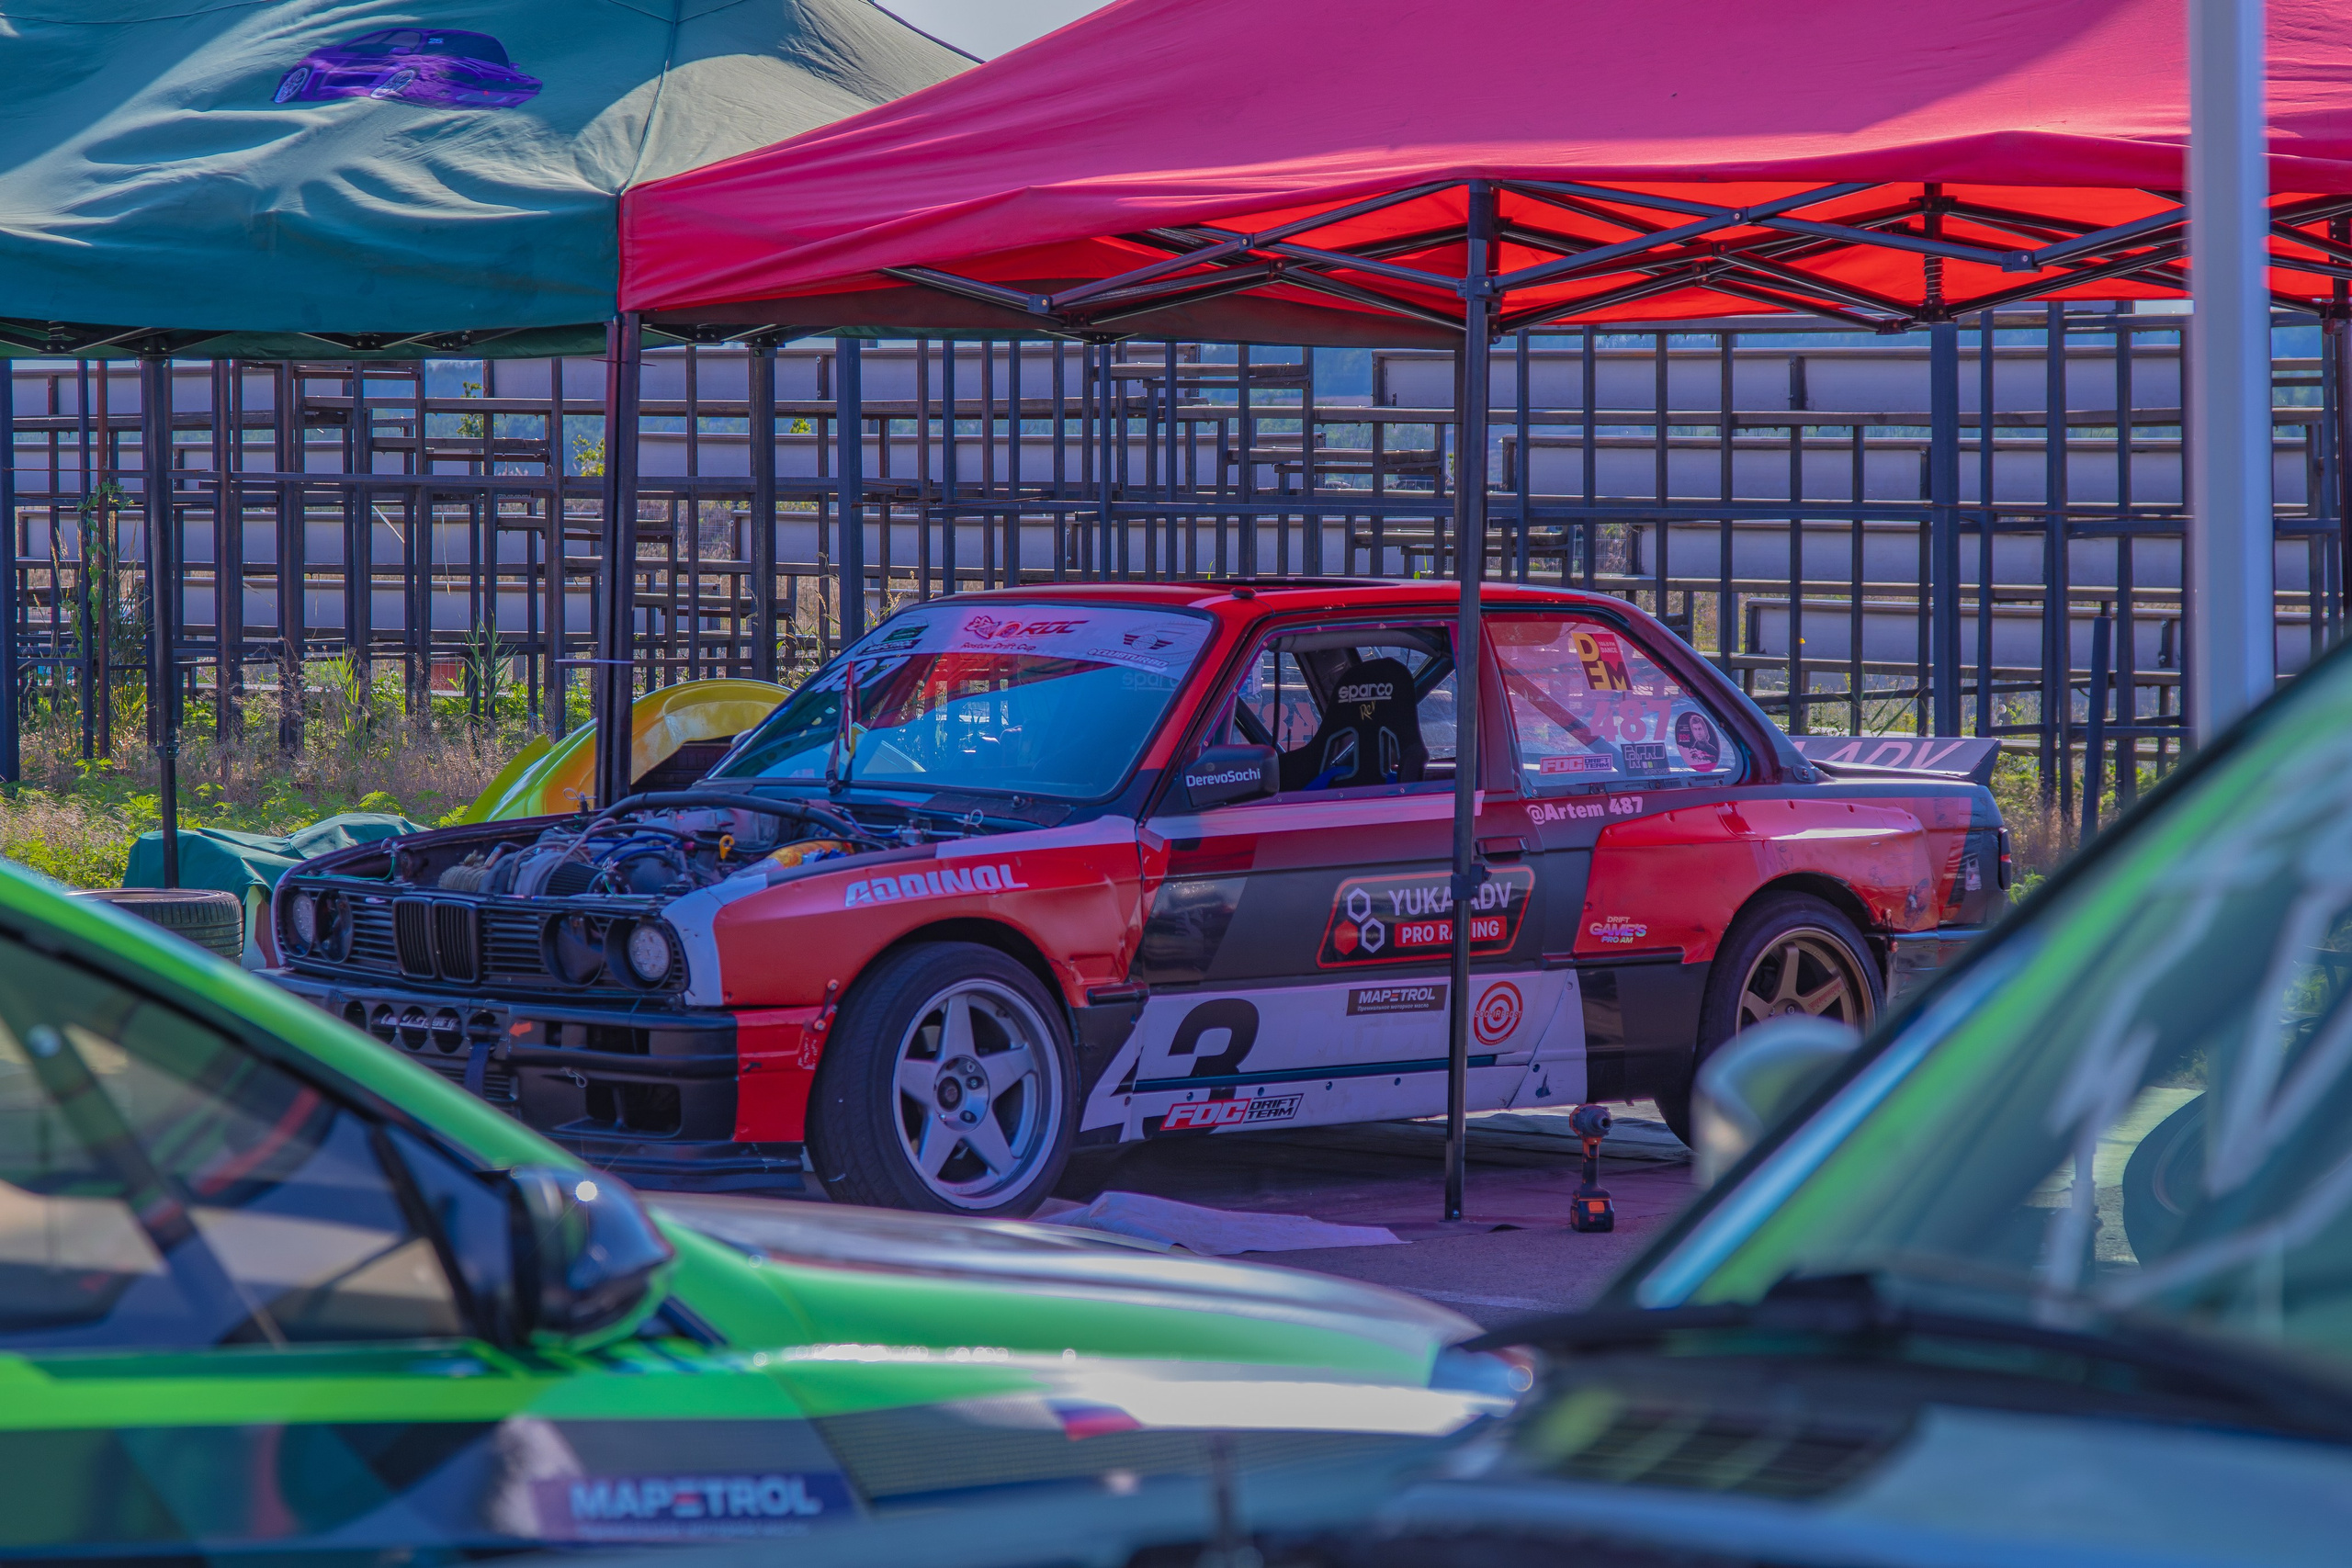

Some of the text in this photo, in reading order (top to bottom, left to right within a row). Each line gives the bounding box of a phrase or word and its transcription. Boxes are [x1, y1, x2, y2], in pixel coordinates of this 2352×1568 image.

[1017, 643, 1036, 651] Cup
[1339, 682, 1394, 703] sparco
[1590, 700, 1671, 742] 487
[1186, 768, 1261, 788] DerevoSochi
[1526, 796, 1644, 825] @Artem 487
[844, 863, 1030, 908] ADDINOL
[1402, 920, 1500, 943] PRO RING
[1359, 987, 1436, 1004] MAPETROL
[1163, 1100, 1250, 1129] FDC
[1247, 1106, 1295, 1120] TEAM
[1250, 1097, 1299, 1111] DRIFT
[569, 1473, 824, 1519] MAPETROL
